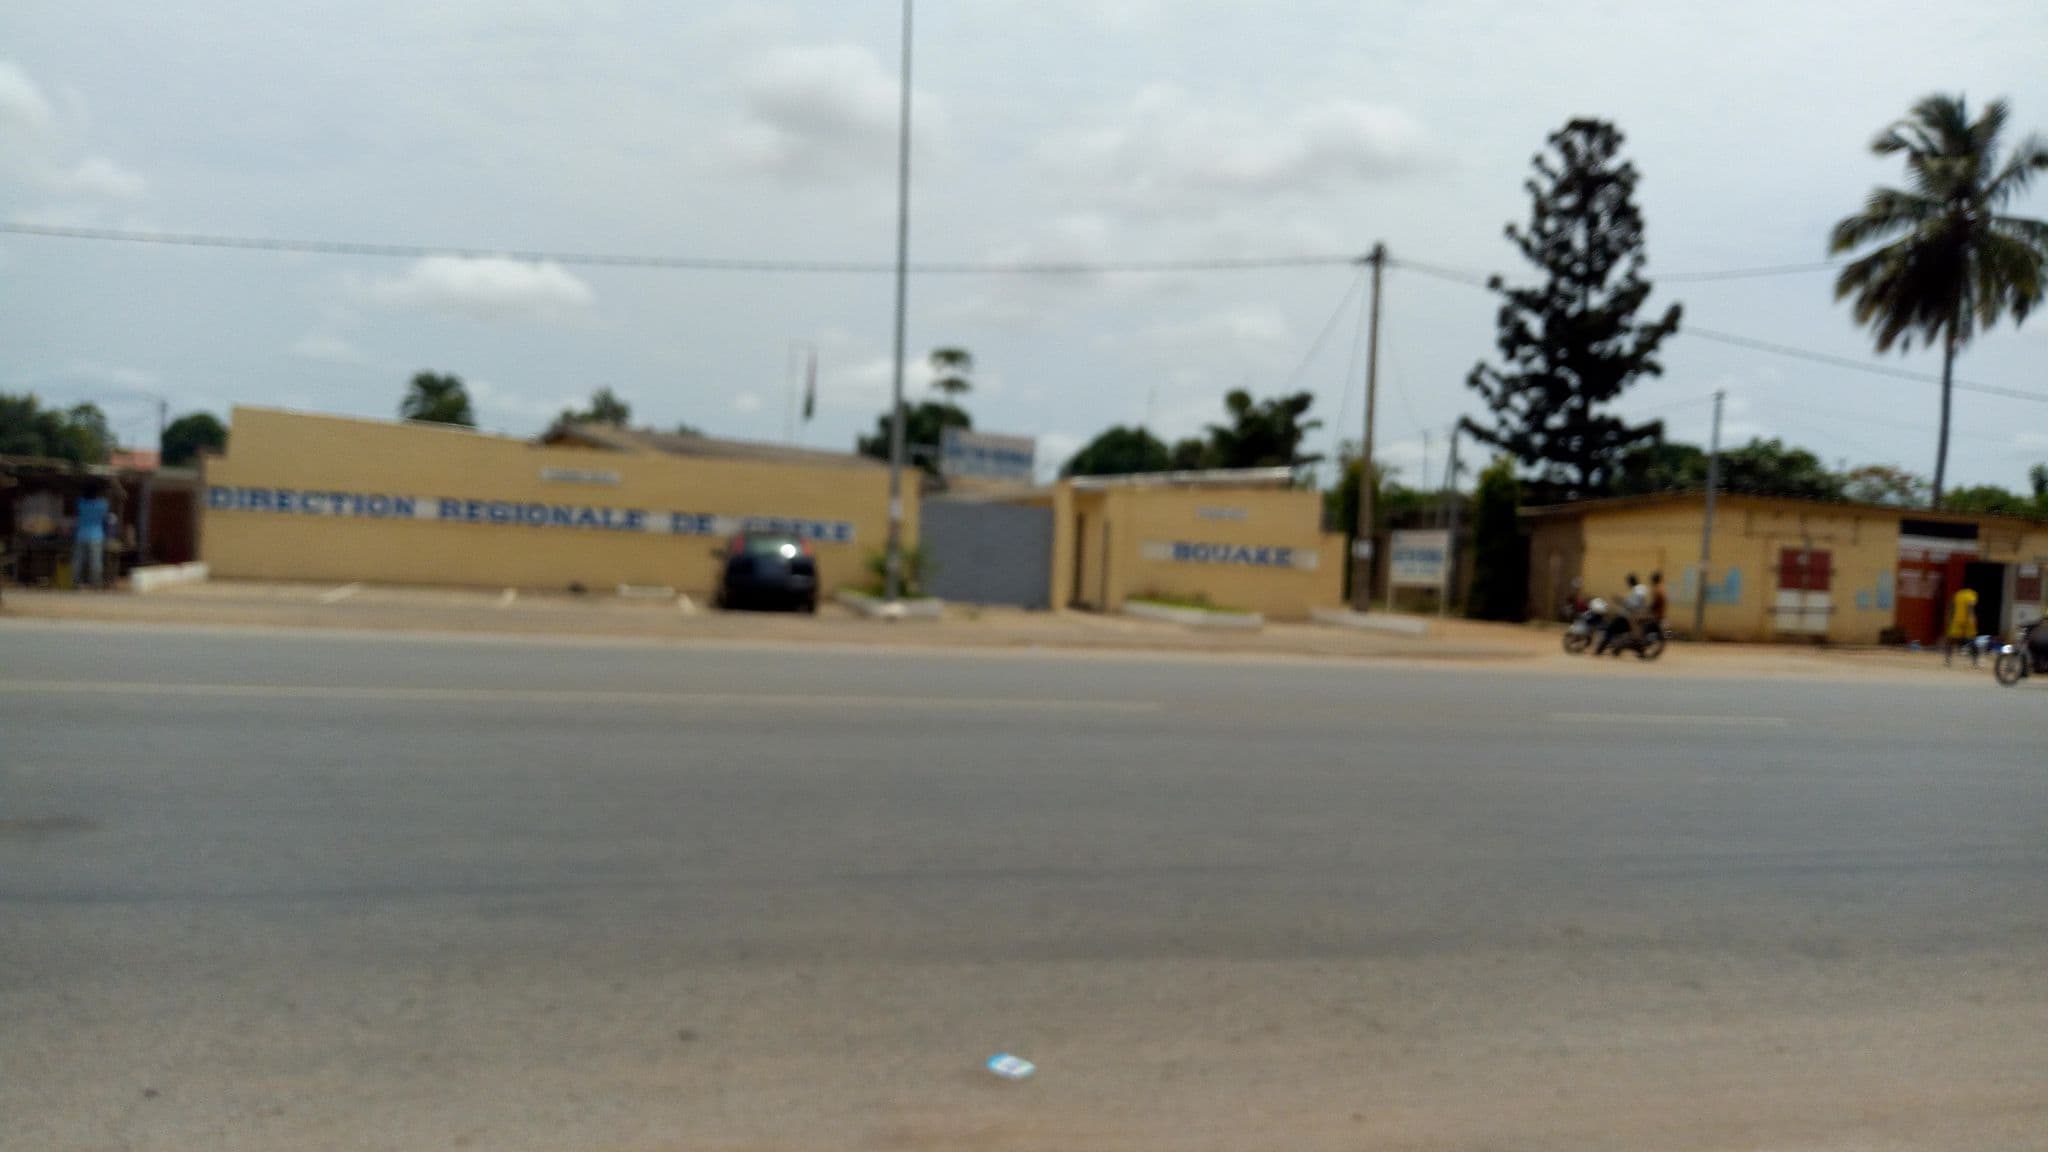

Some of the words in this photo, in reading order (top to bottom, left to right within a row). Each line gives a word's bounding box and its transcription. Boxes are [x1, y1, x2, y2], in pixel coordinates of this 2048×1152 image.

[210, 486, 415, 516] DIRECTION
[438, 498, 645, 531] REGIONALE
[671, 512, 714, 532] DE
